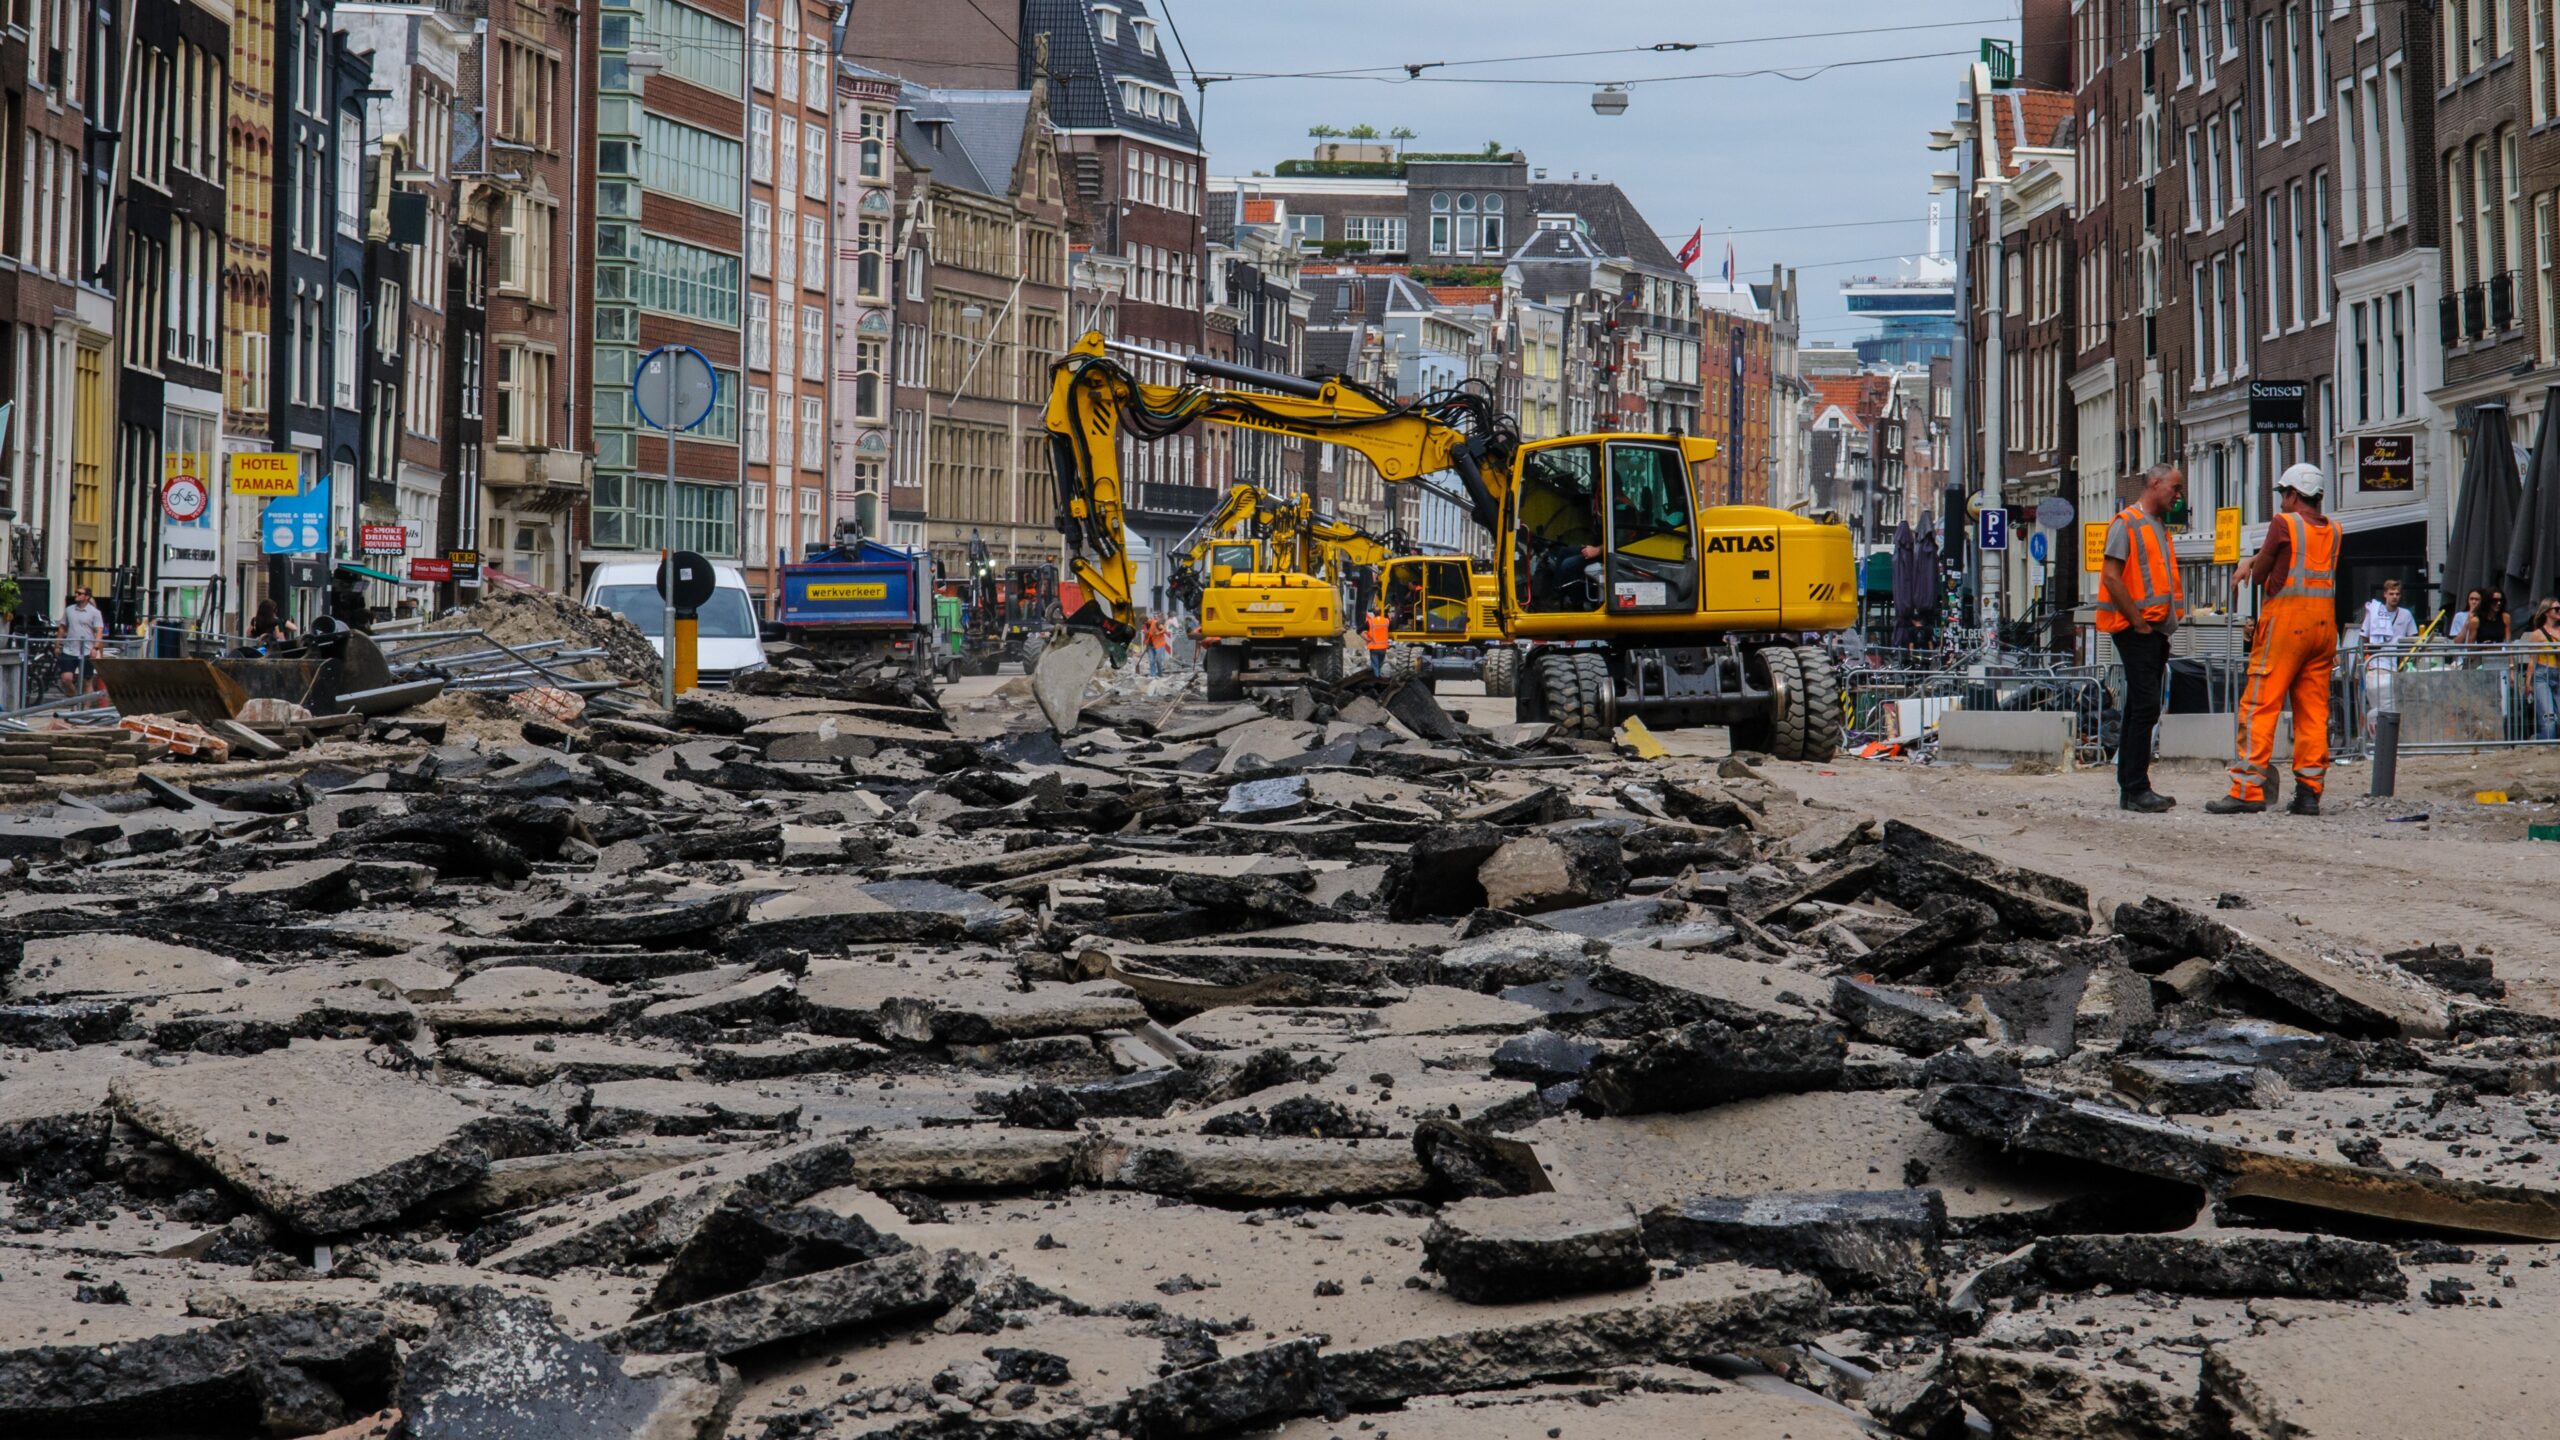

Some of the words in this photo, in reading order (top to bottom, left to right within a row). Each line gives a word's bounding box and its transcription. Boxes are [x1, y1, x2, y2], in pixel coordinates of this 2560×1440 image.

[2252, 383, 2291, 397] Sense
[2277, 421, 2285, 429] in
[2286, 422, 2298, 430] spa
[2374, 438, 2398, 447] Siam
[241, 458, 288, 471] HOTEL
[2361, 456, 2411, 466] Restaurant
[234, 478, 294, 490] TAMARA
[1988, 514, 1999, 531] P
[1706, 535, 1775, 553] ATLAS
[811, 587, 882, 597] werkverkeer
[1246, 602, 1285, 612] ATLAS
